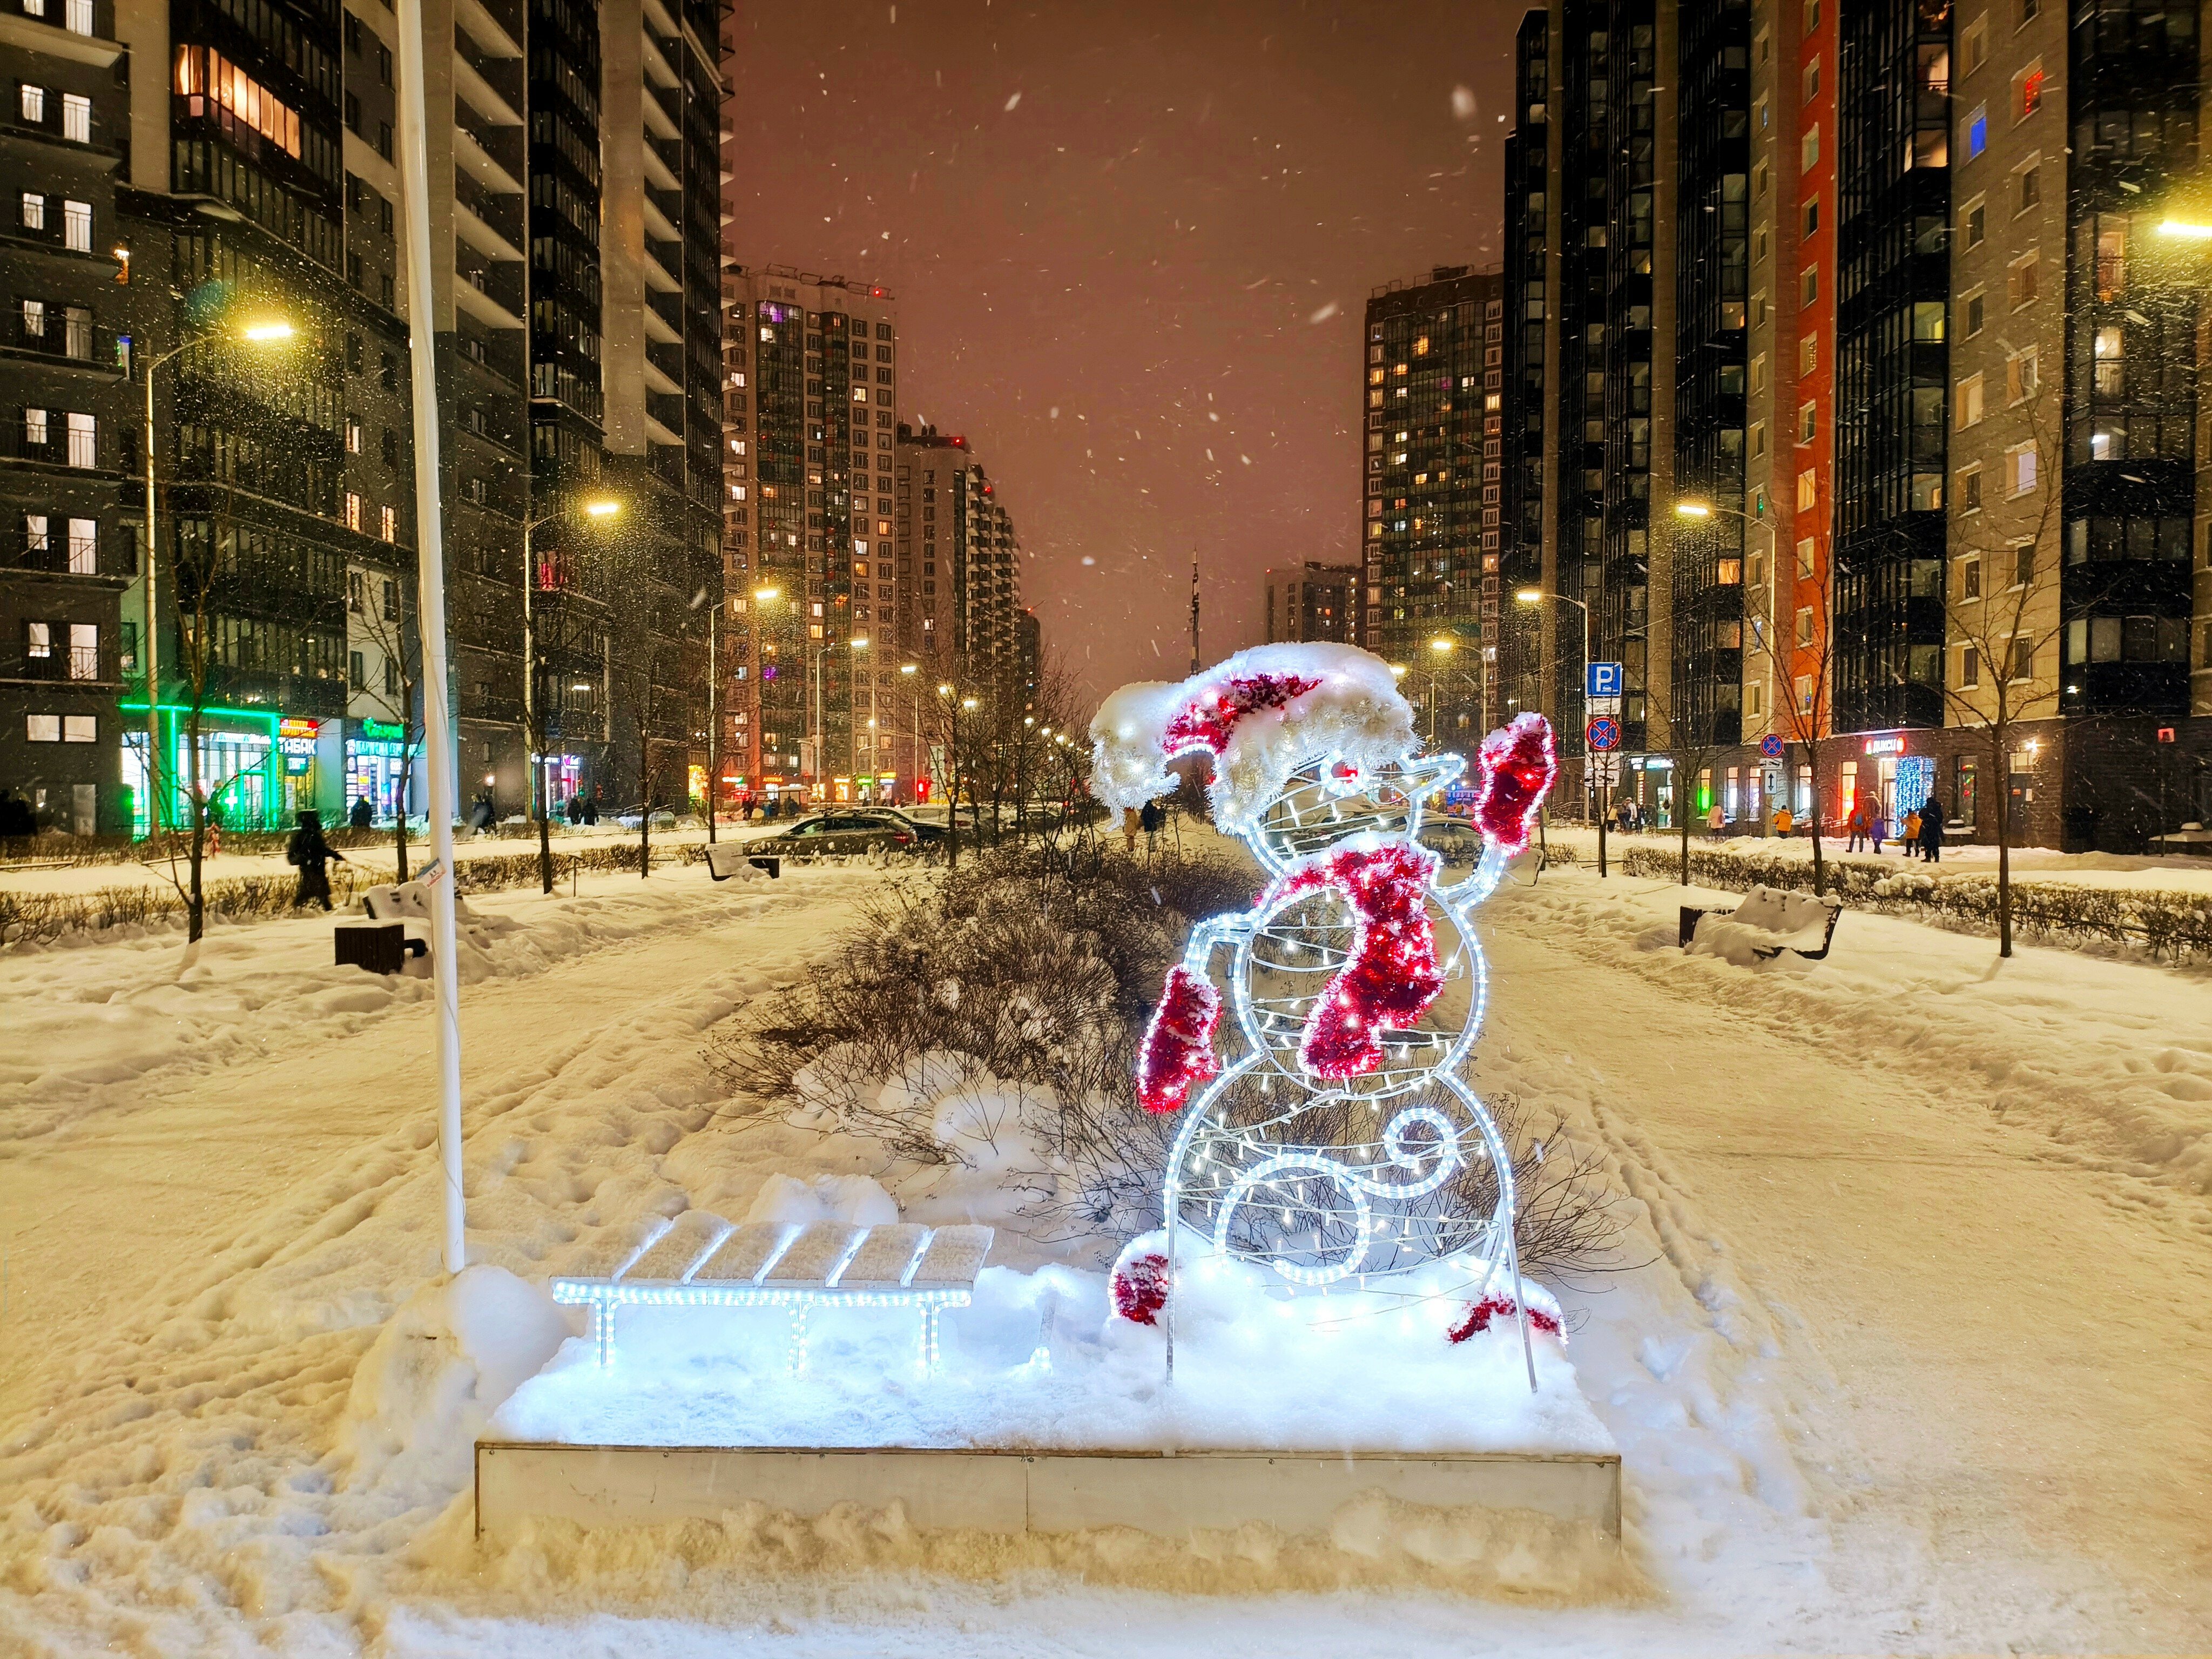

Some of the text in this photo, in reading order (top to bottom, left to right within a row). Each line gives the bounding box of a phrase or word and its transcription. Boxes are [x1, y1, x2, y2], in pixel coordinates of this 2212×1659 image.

[1596, 666, 1613, 692] P
[277, 737, 317, 754] ТАБАК
[1873, 739, 1897, 753] ДИКСИ
